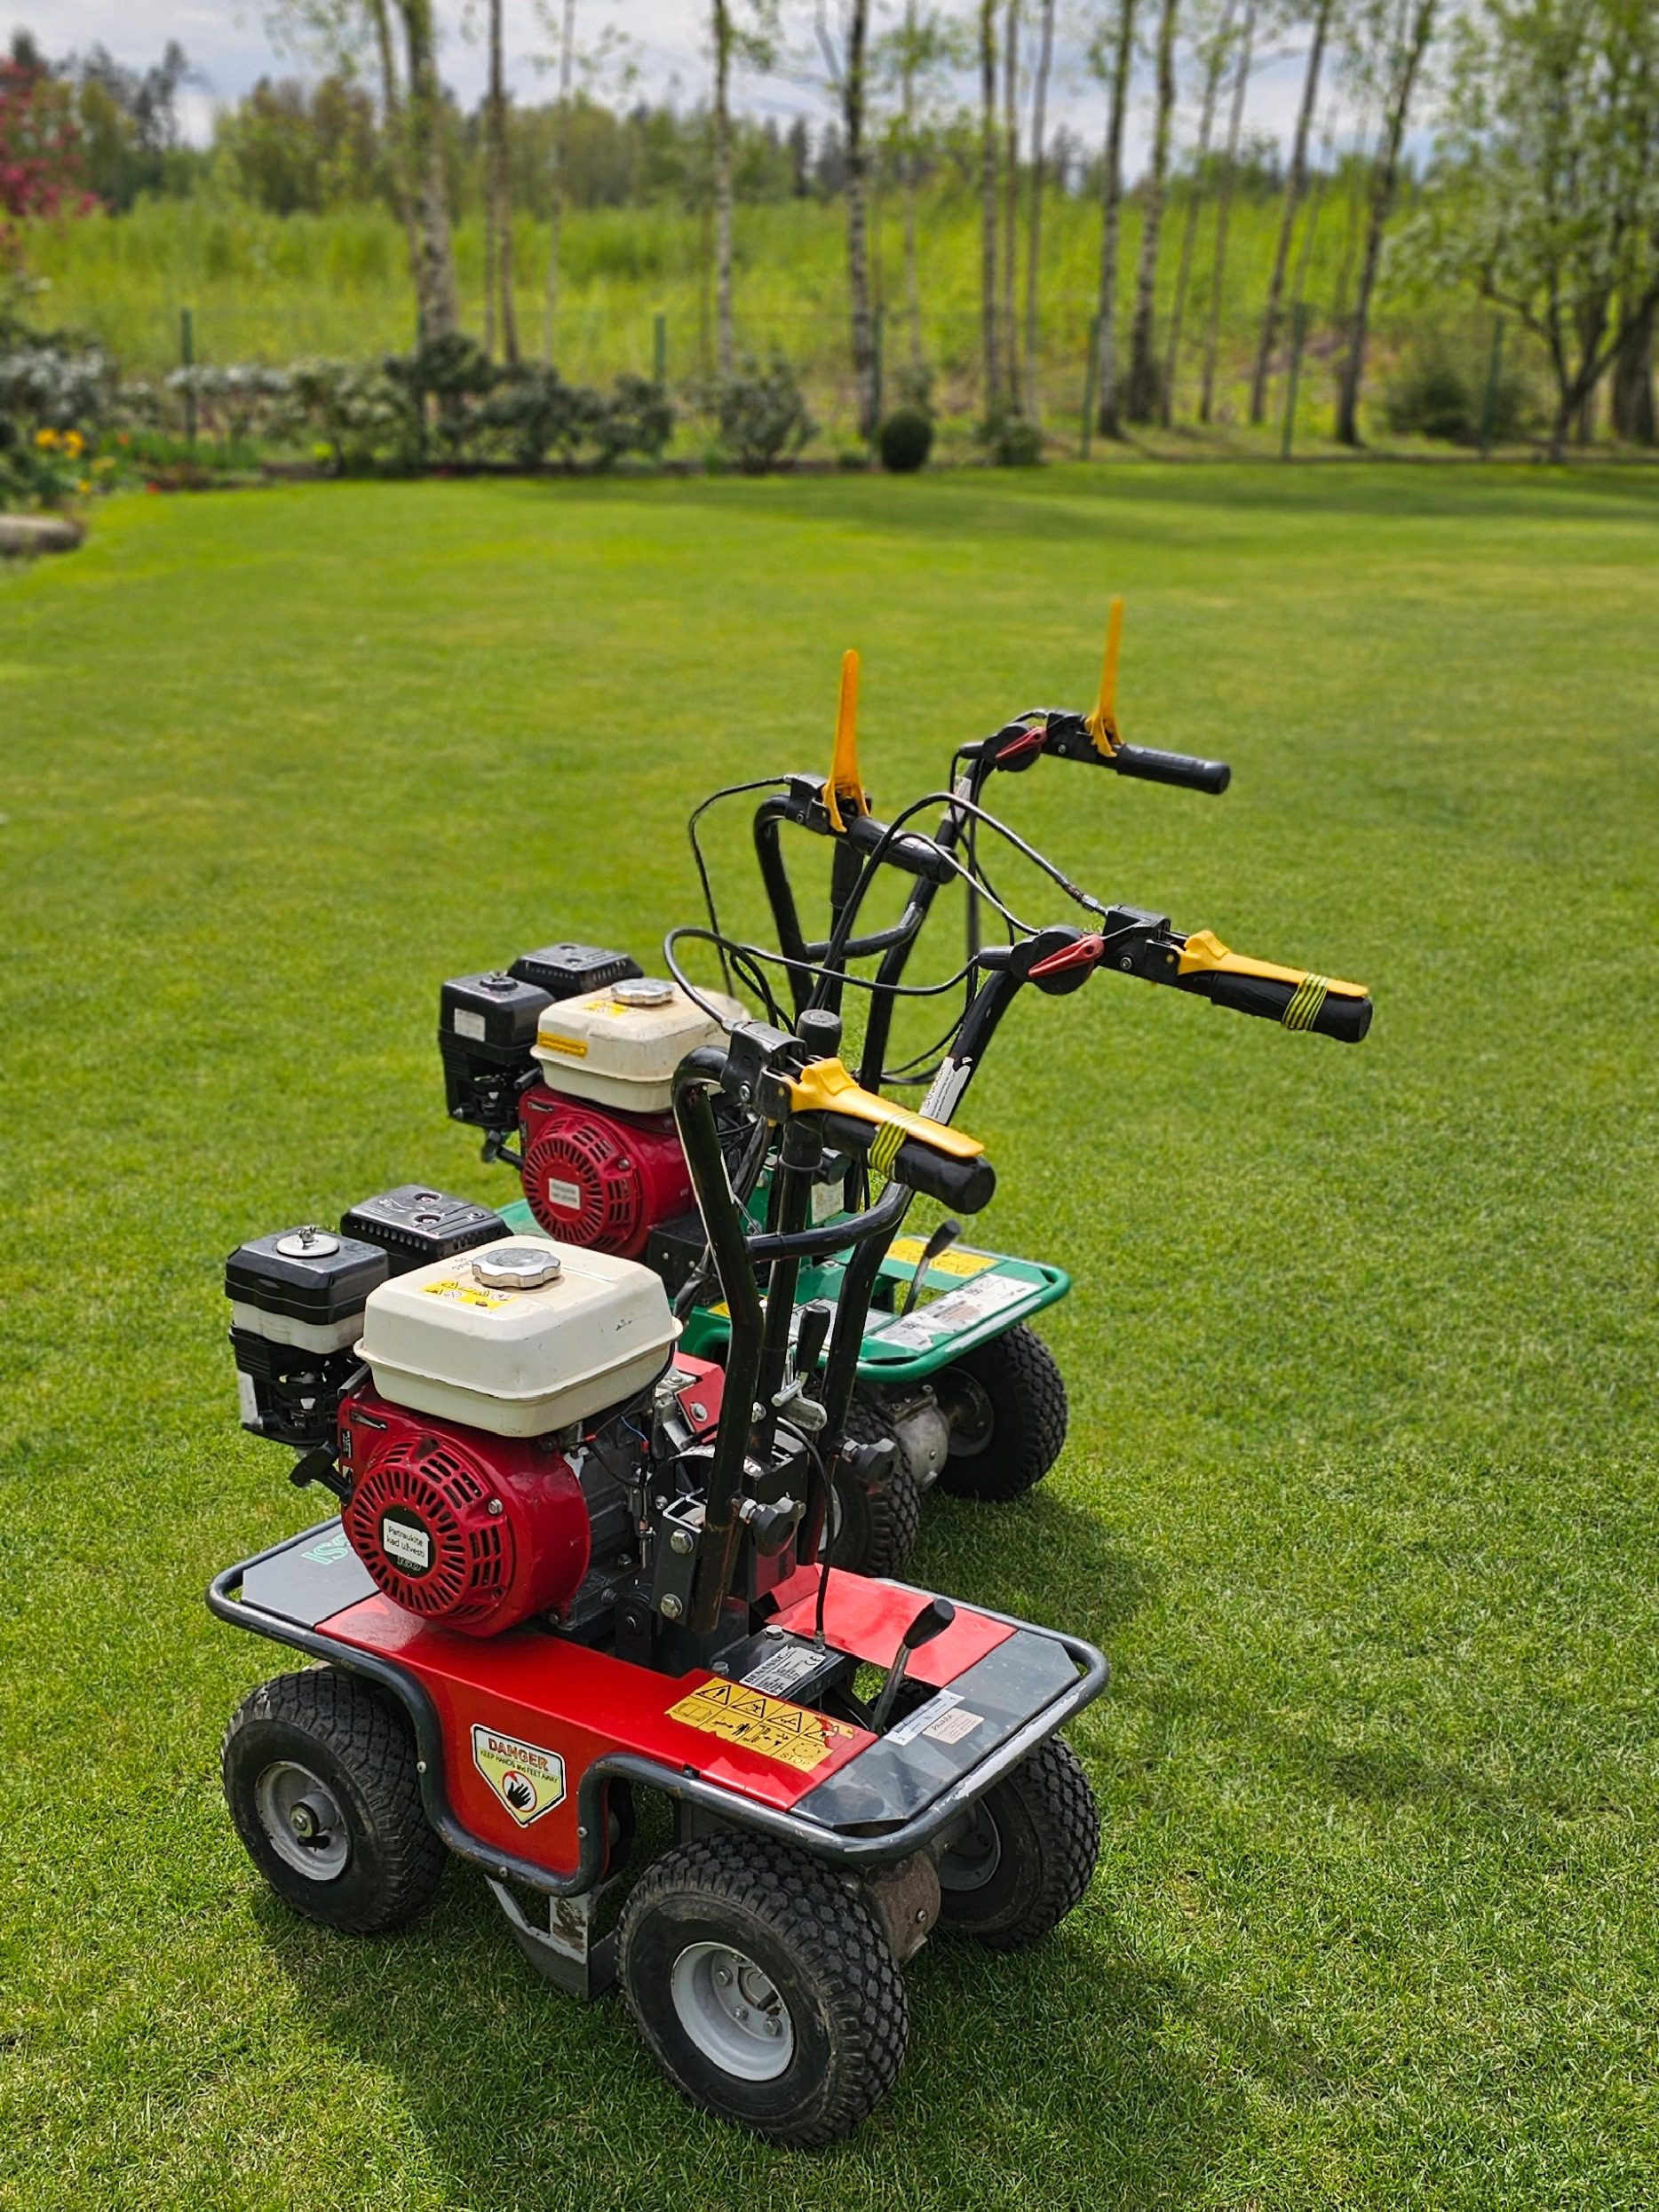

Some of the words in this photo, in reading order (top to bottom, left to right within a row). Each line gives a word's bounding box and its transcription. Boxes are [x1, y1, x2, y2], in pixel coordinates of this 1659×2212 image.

[480, 1749, 495, 1759] KEEP
[527, 1766, 541, 1778] FEET
[542, 1772, 559, 1784] AWAY
[488, 1737, 549, 1772] DANGER
[780, 1752, 811, 1765] STOP
